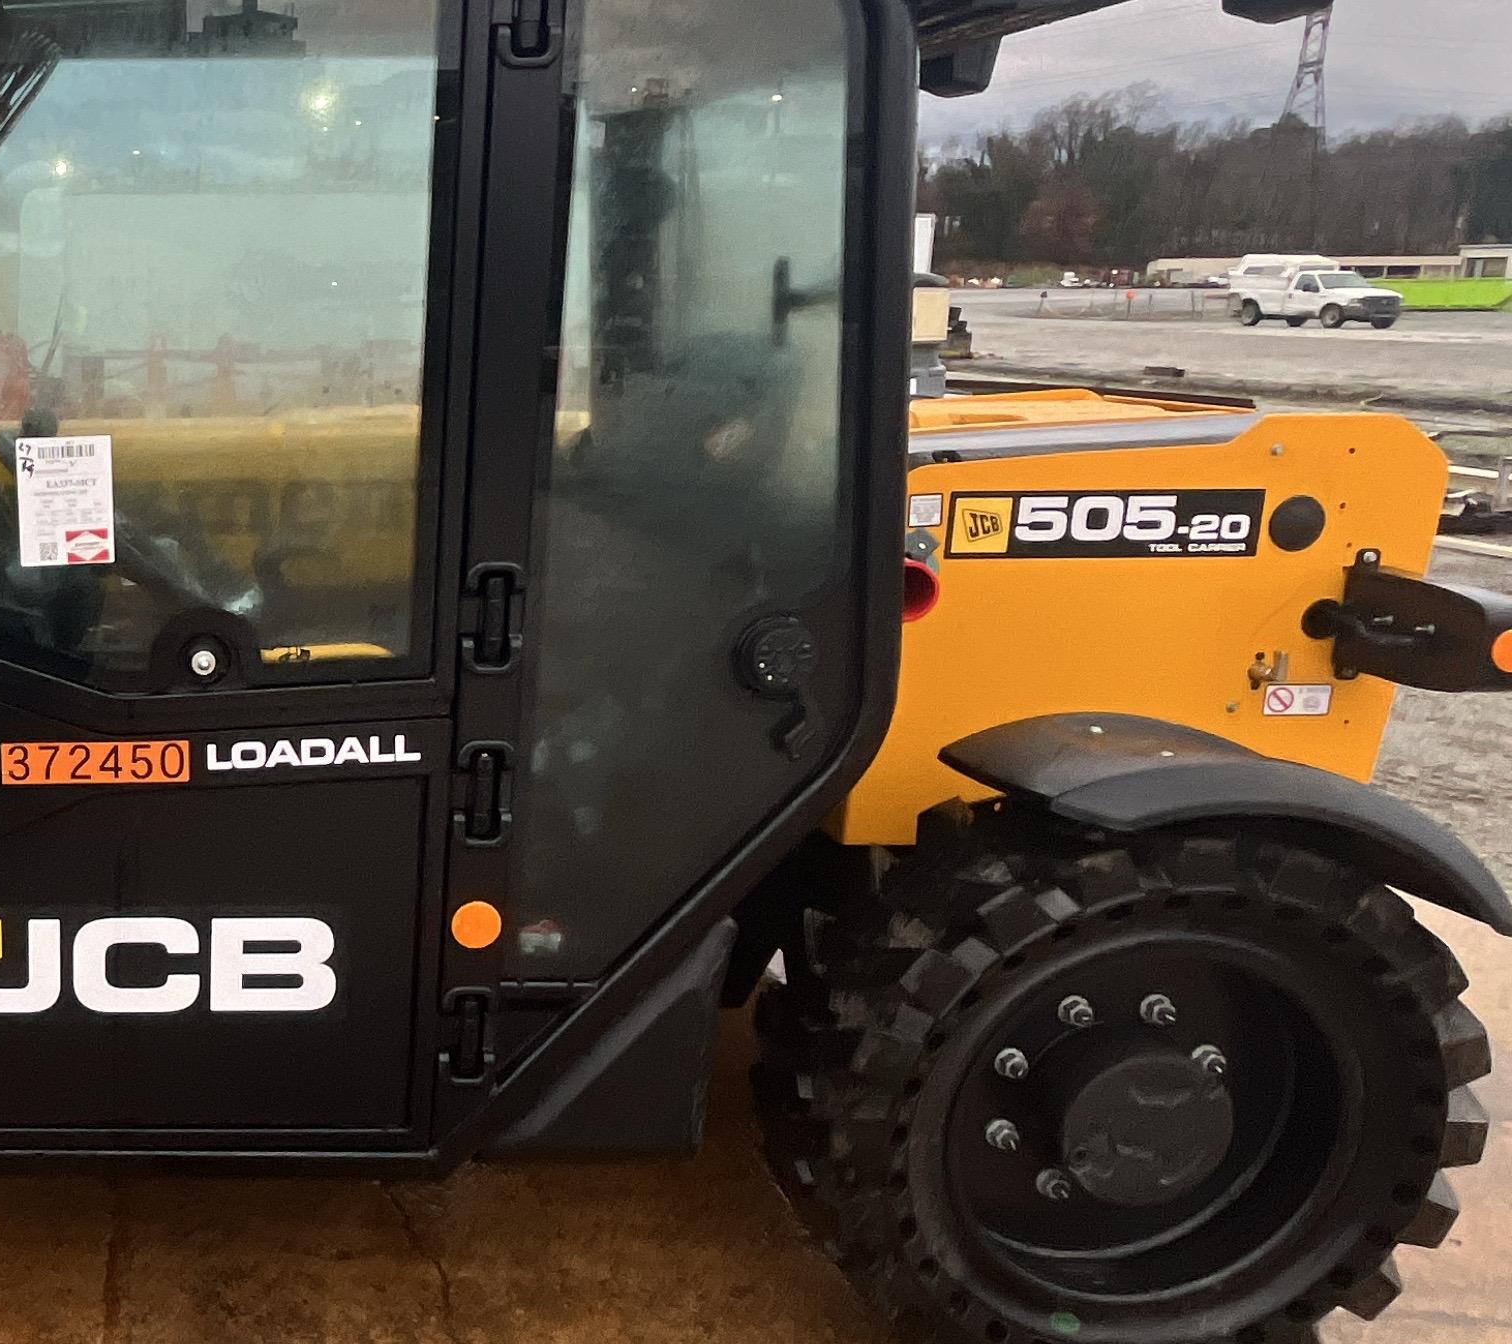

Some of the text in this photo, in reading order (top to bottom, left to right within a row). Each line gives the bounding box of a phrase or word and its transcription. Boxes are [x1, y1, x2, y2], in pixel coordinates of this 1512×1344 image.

[968, 511, 1002, 539] JCB
[1013, 495, 1252, 542] 505-20
[1148, 542, 1247, 553] TOOL CARRIER
[6, 743, 186, 782] 372450
[206, 734, 423, 771] LOADALL
